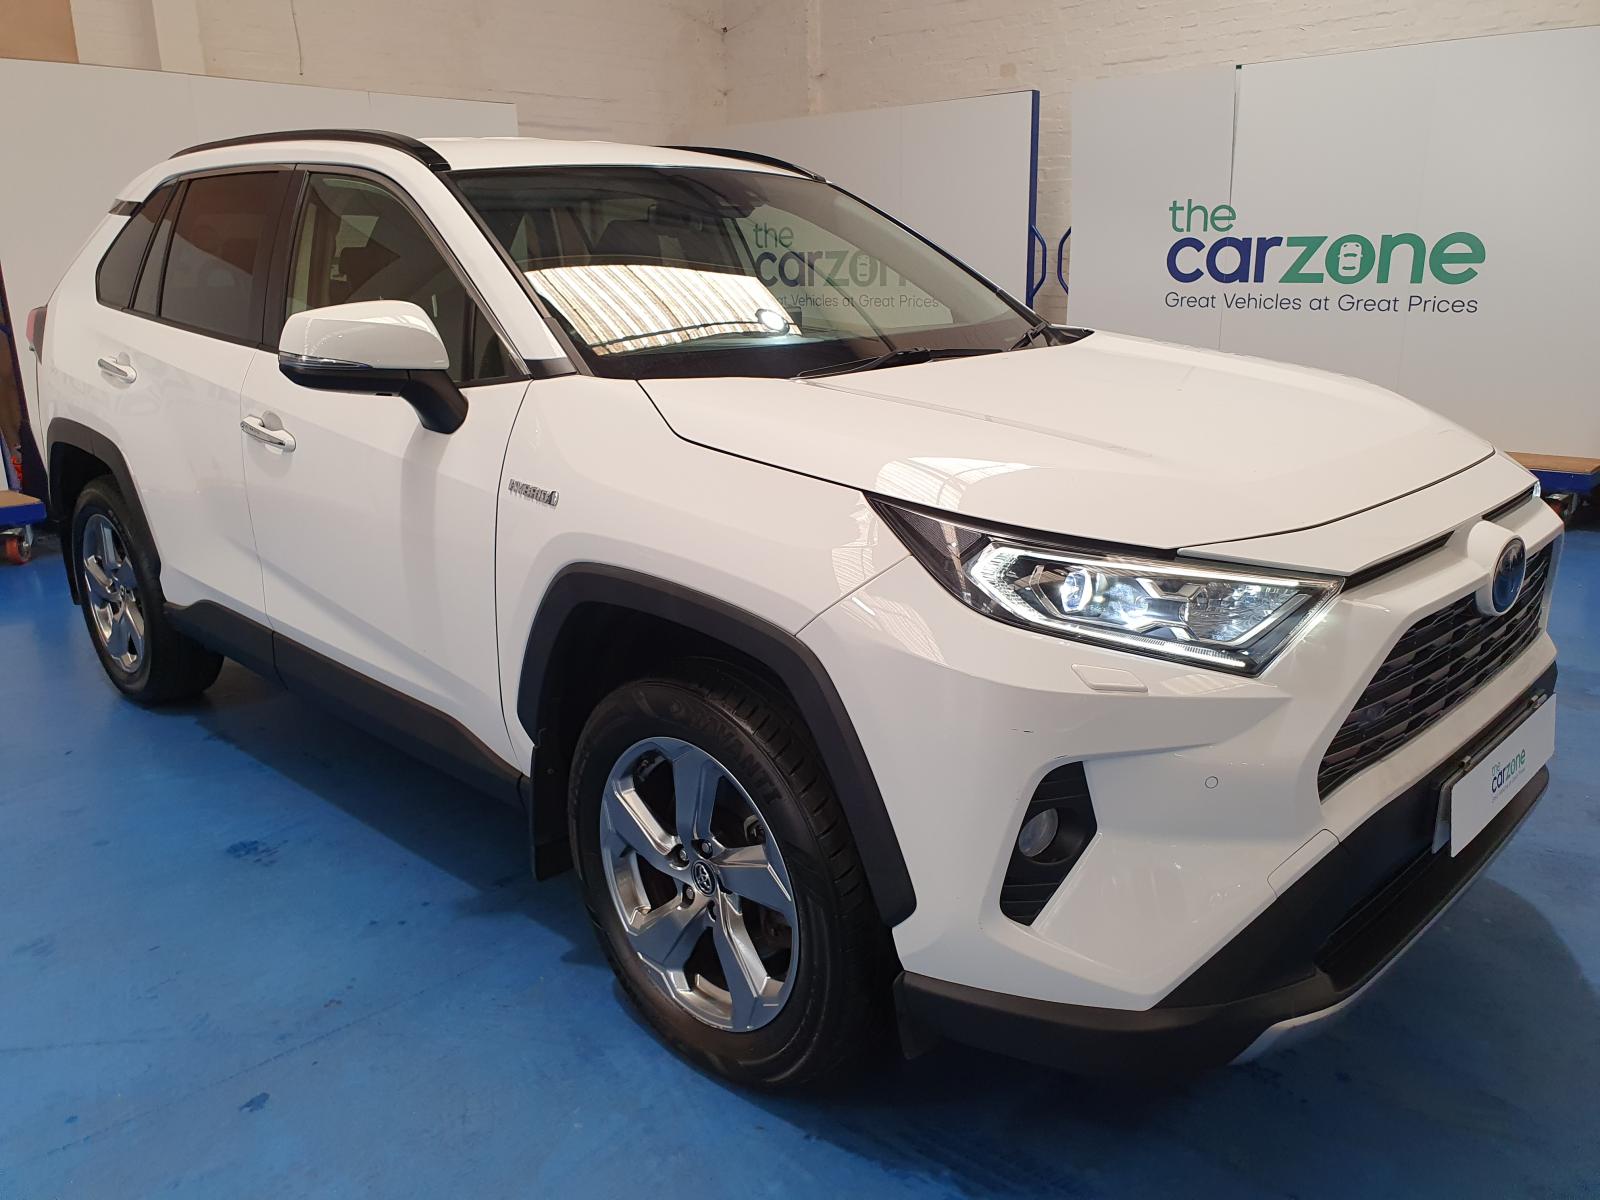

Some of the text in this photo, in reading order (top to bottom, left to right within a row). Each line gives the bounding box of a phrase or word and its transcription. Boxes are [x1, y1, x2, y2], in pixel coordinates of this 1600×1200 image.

[1169, 198, 1237, 232] the
[753, 222, 794, 249] the
[1166, 231, 1486, 285] carzone
[791, 293, 839, 308] Vehicles
[842, 296, 855, 308] at
[858, 293, 896, 308] Great
[899, 294, 940, 308] Prices
[1165, 291, 1479, 314] Great Vehicles at Great Prices
[1491, 748, 1526, 793] carzone
